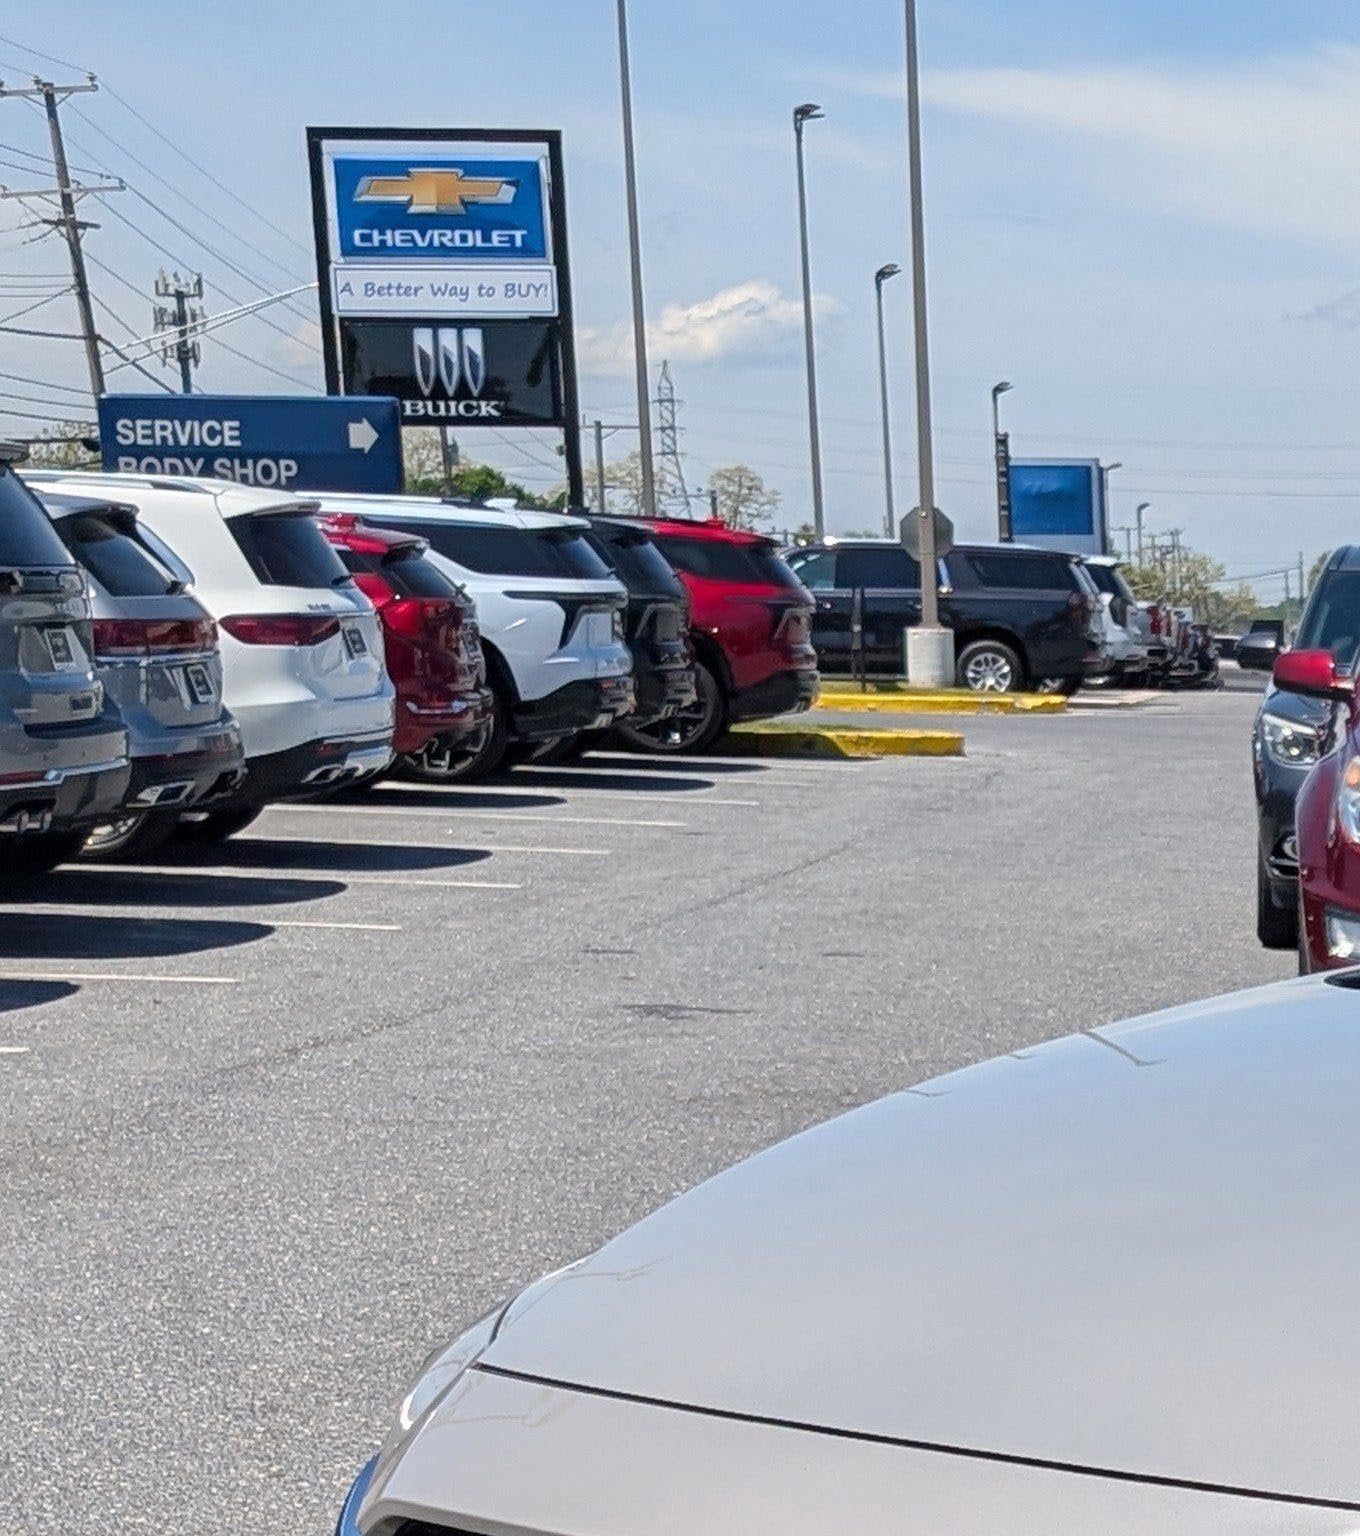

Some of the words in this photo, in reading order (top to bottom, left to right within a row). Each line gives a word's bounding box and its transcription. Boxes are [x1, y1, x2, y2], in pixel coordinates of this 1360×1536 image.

[353, 229, 528, 248] CHEVROLET
[339, 282, 355, 297] A
[364, 281, 424, 298] Better
[430, 282, 471, 302] Way
[478, 283, 496, 298] to
[504, 282, 549, 298] BUY!
[403, 400, 502, 418] BUICK
[115, 418, 242, 447] SERVICE
[213, 457, 298, 486] SHOP
